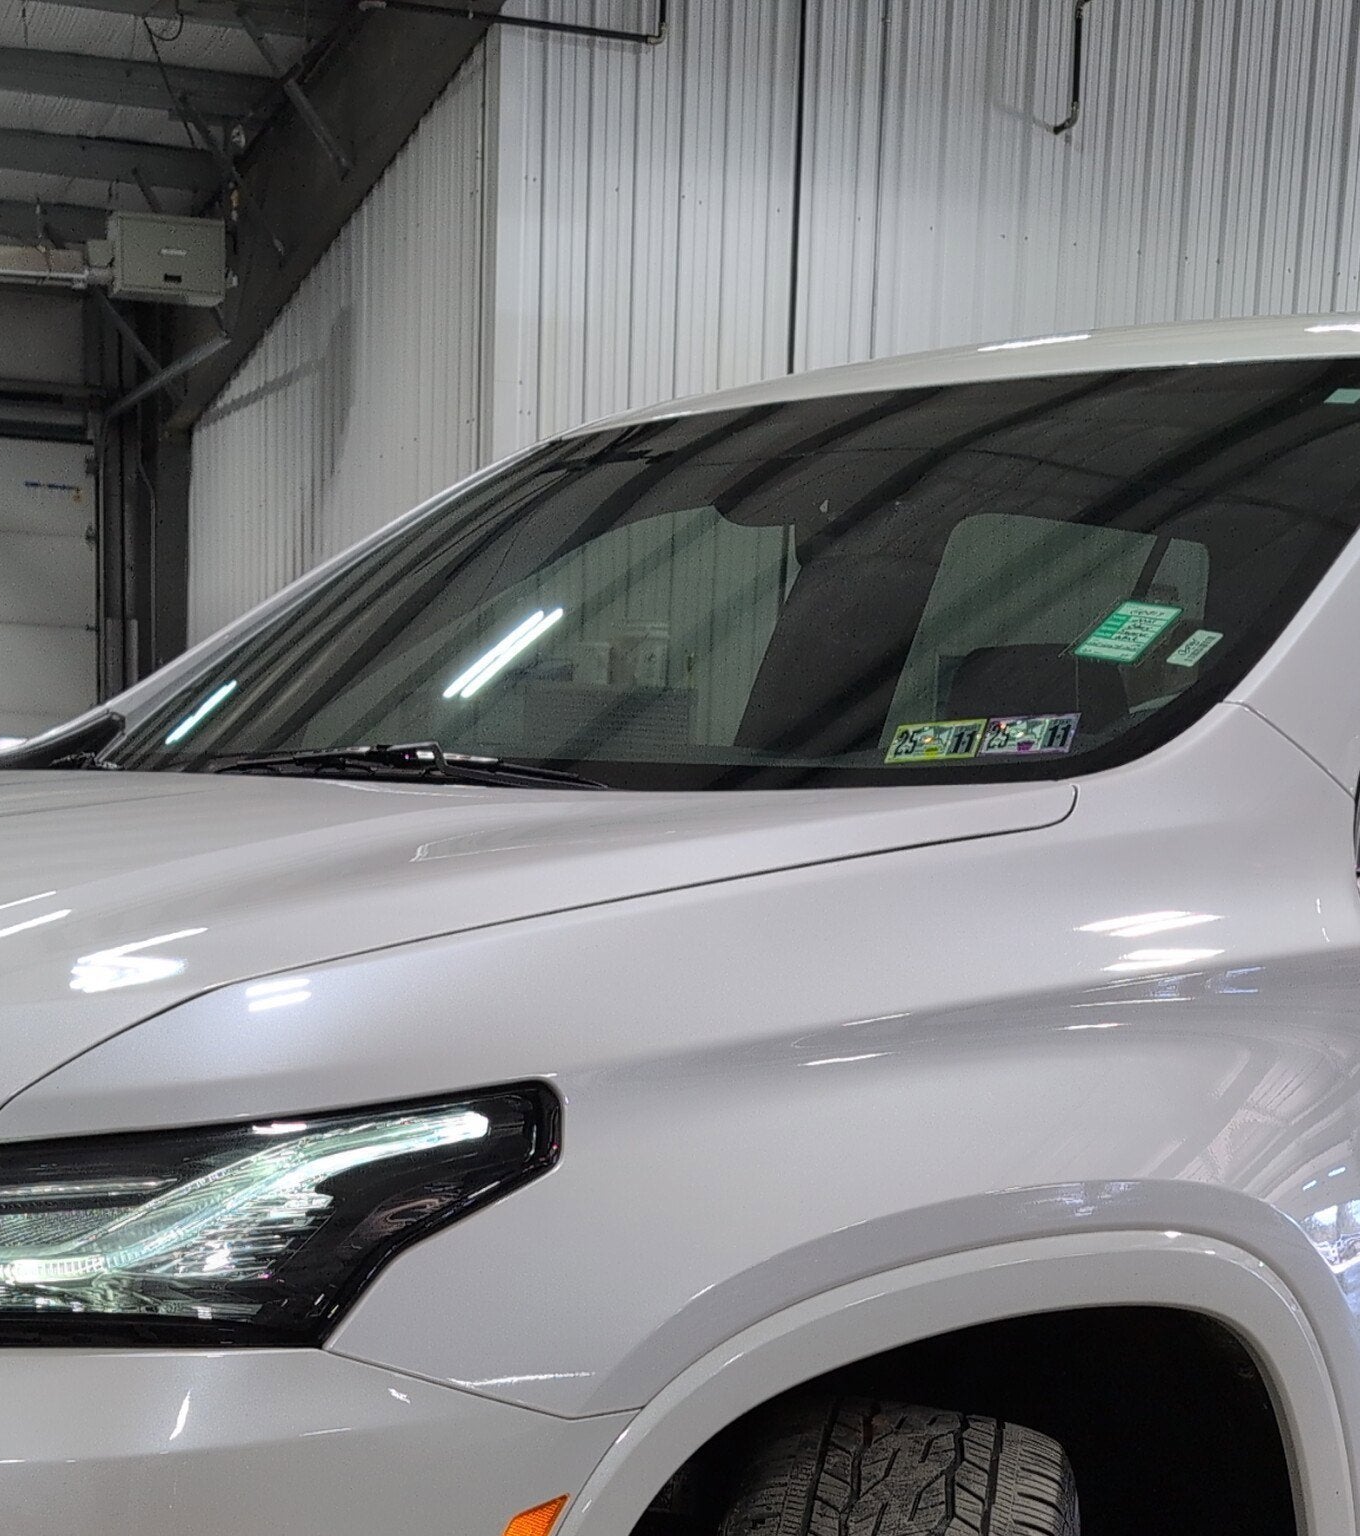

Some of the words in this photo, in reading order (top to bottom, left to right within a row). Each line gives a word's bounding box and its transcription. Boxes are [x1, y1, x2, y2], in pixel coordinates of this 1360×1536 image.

[894, 729, 917, 756] 25
[949, 730, 977, 754] 11
[987, 722, 1010, 751] 25
[1046, 723, 1073, 748] 11
